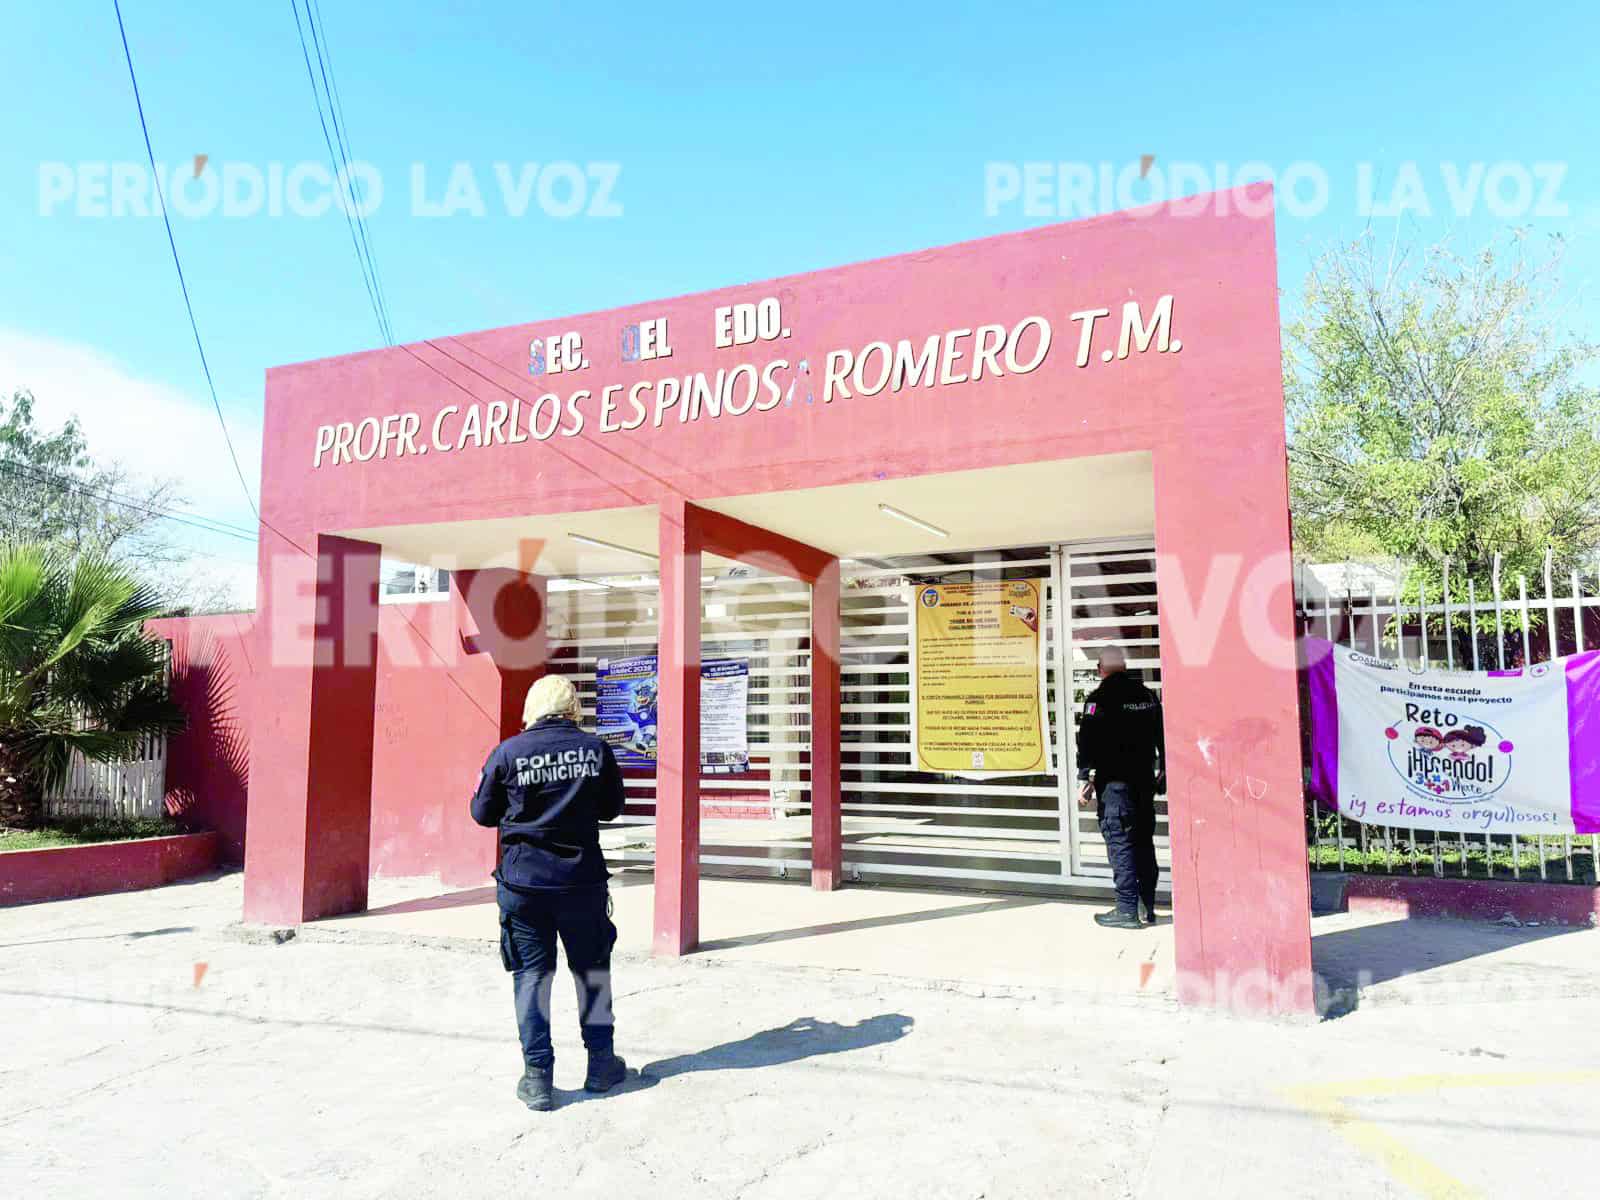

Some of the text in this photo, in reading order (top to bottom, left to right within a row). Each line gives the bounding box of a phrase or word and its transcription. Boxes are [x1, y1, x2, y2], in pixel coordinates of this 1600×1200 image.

[528, 297, 791, 377] SEC. DEL EDO.
[313, 412, 429, 468] PROFR.
[431, 390, 592, 452] CARLOS
[823, 316, 1053, 404] ROMERO
[1070, 295, 1184, 368] T.M.
[1380, 684, 1513, 706] participamos en el proyecto
[1408, 681, 1482, 696] En esta escuela
[1405, 703, 1459, 728] Reto
[515, 746, 598, 771] POLICÍA
[517, 762, 600, 787] MUNICIPAL
[1376, 796, 1451, 819] estamos
[1462, 805, 1558, 829] orgullosos!
